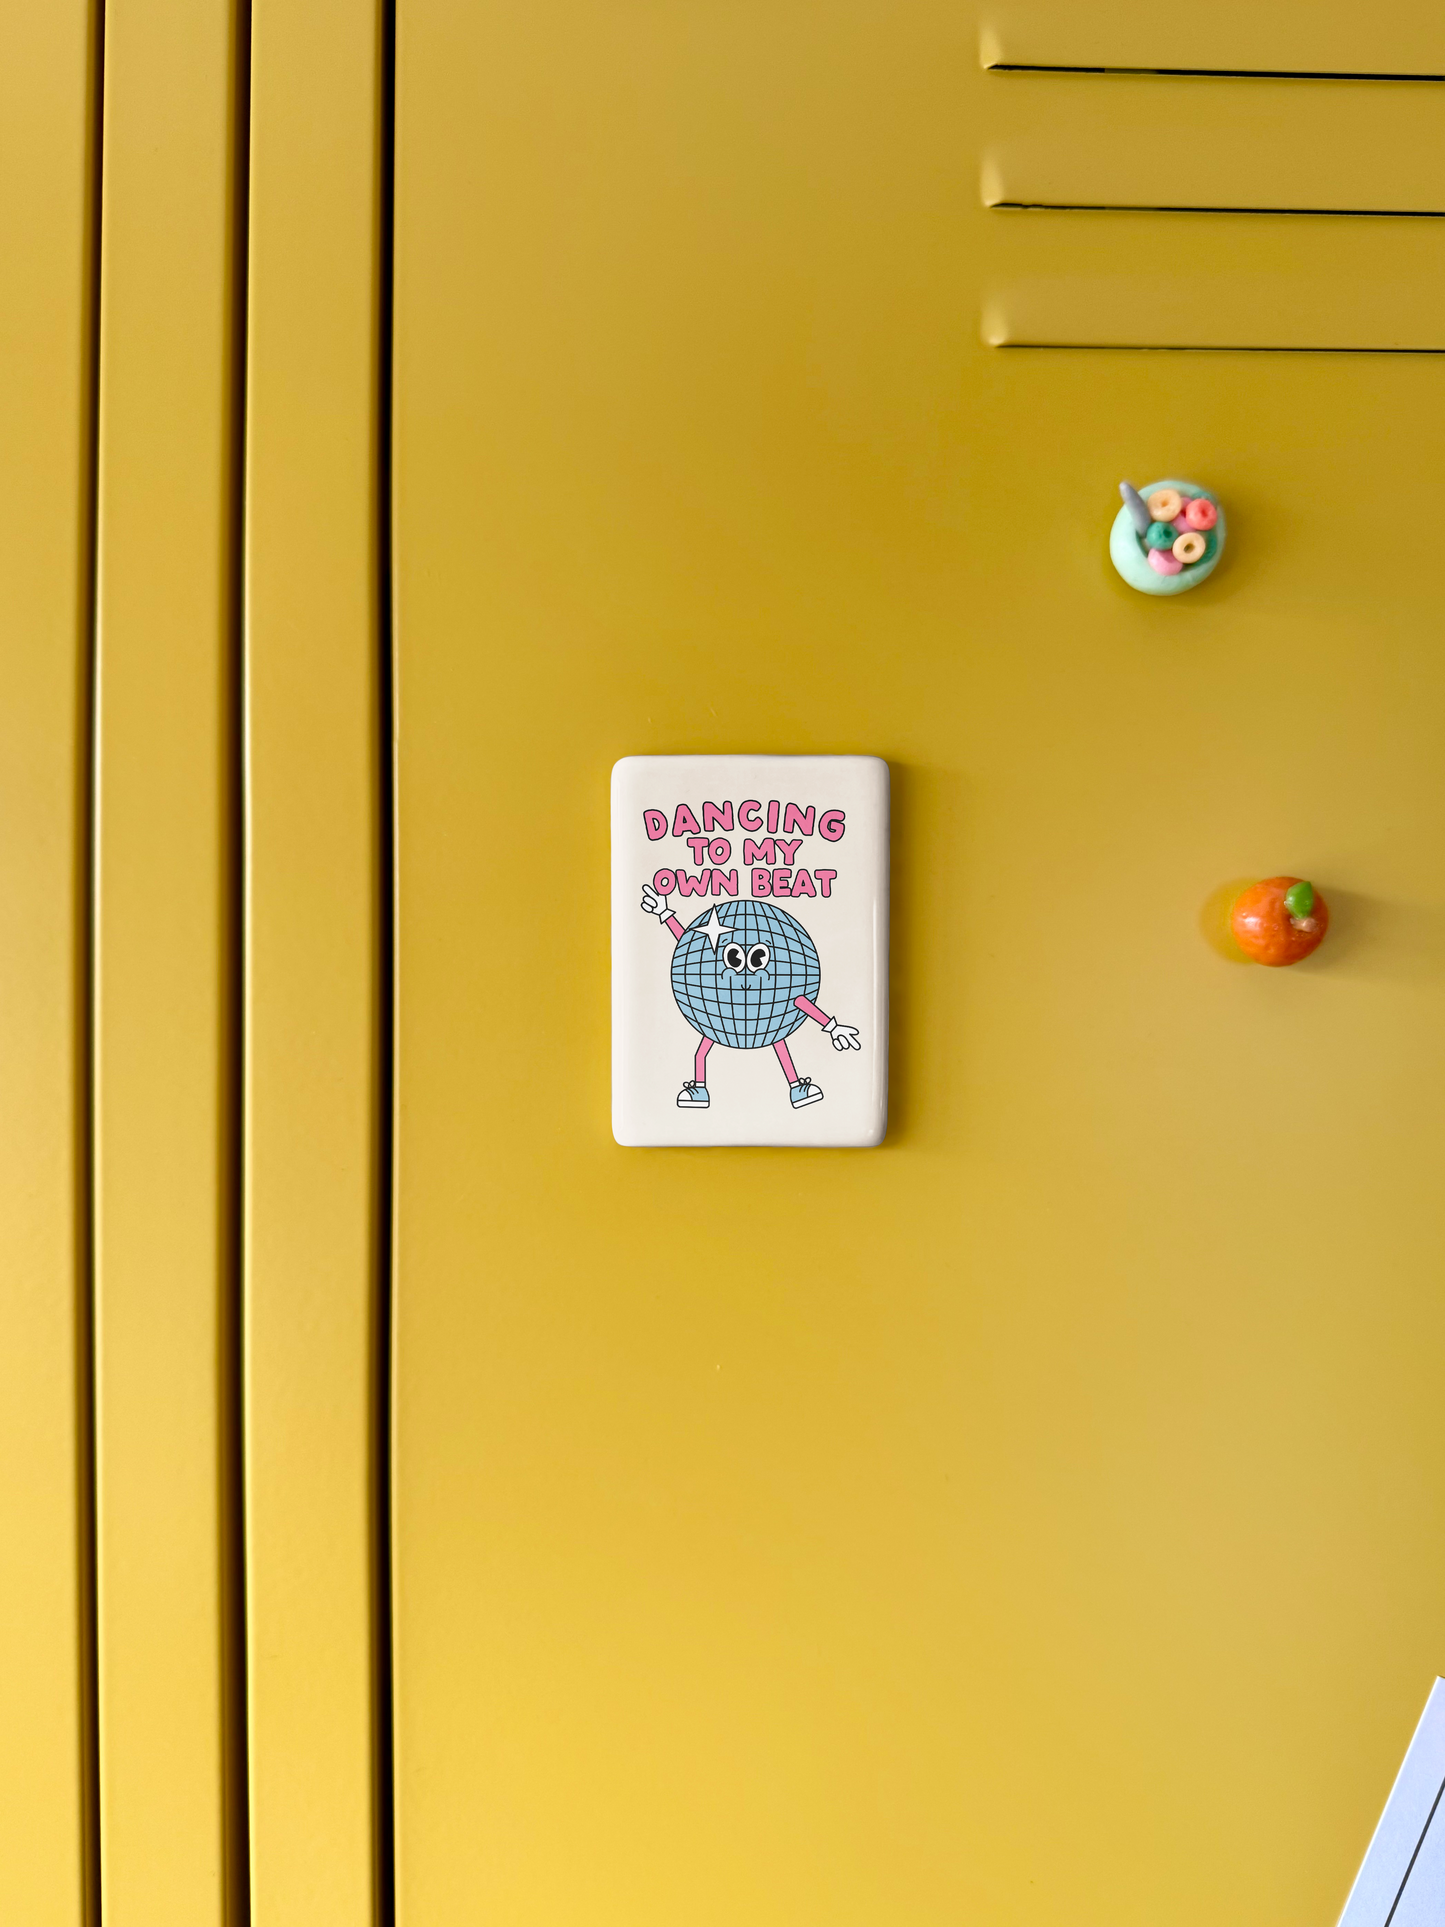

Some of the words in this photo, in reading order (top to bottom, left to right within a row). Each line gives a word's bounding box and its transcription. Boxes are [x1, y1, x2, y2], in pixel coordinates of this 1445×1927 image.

[643, 800, 846, 842] DANCING
[687, 837, 731, 866] TO
[743, 837, 803, 866] MY
[653, 868, 739, 897] OWN
[751, 868, 837, 898] BEAT
